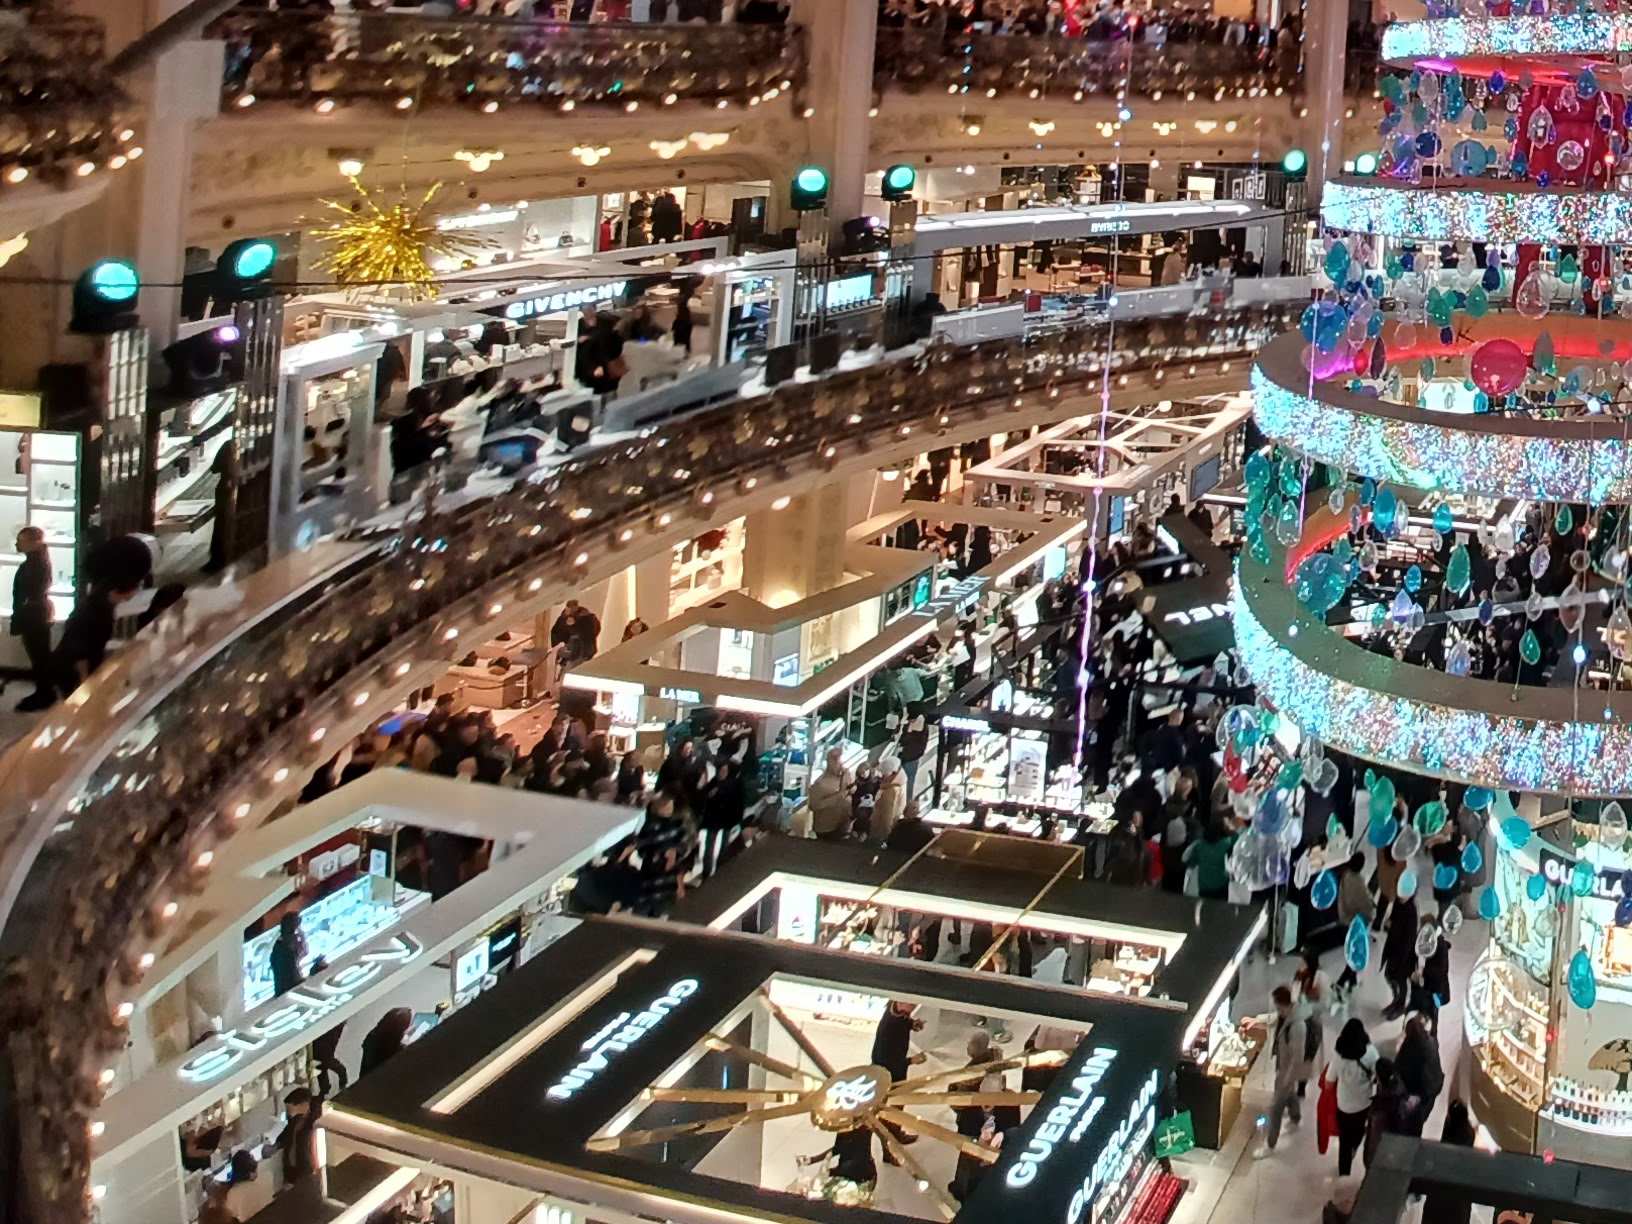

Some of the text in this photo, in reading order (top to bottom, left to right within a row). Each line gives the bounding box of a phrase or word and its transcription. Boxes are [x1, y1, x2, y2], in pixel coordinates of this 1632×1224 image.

[505, 281, 627, 319] GIVENCHY
[546, 979, 699, 1100] GUERLAIN
[1005, 1047, 1119, 1189] GUERLAIN
[1066, 1068, 1159, 1224] GUERLAIN
